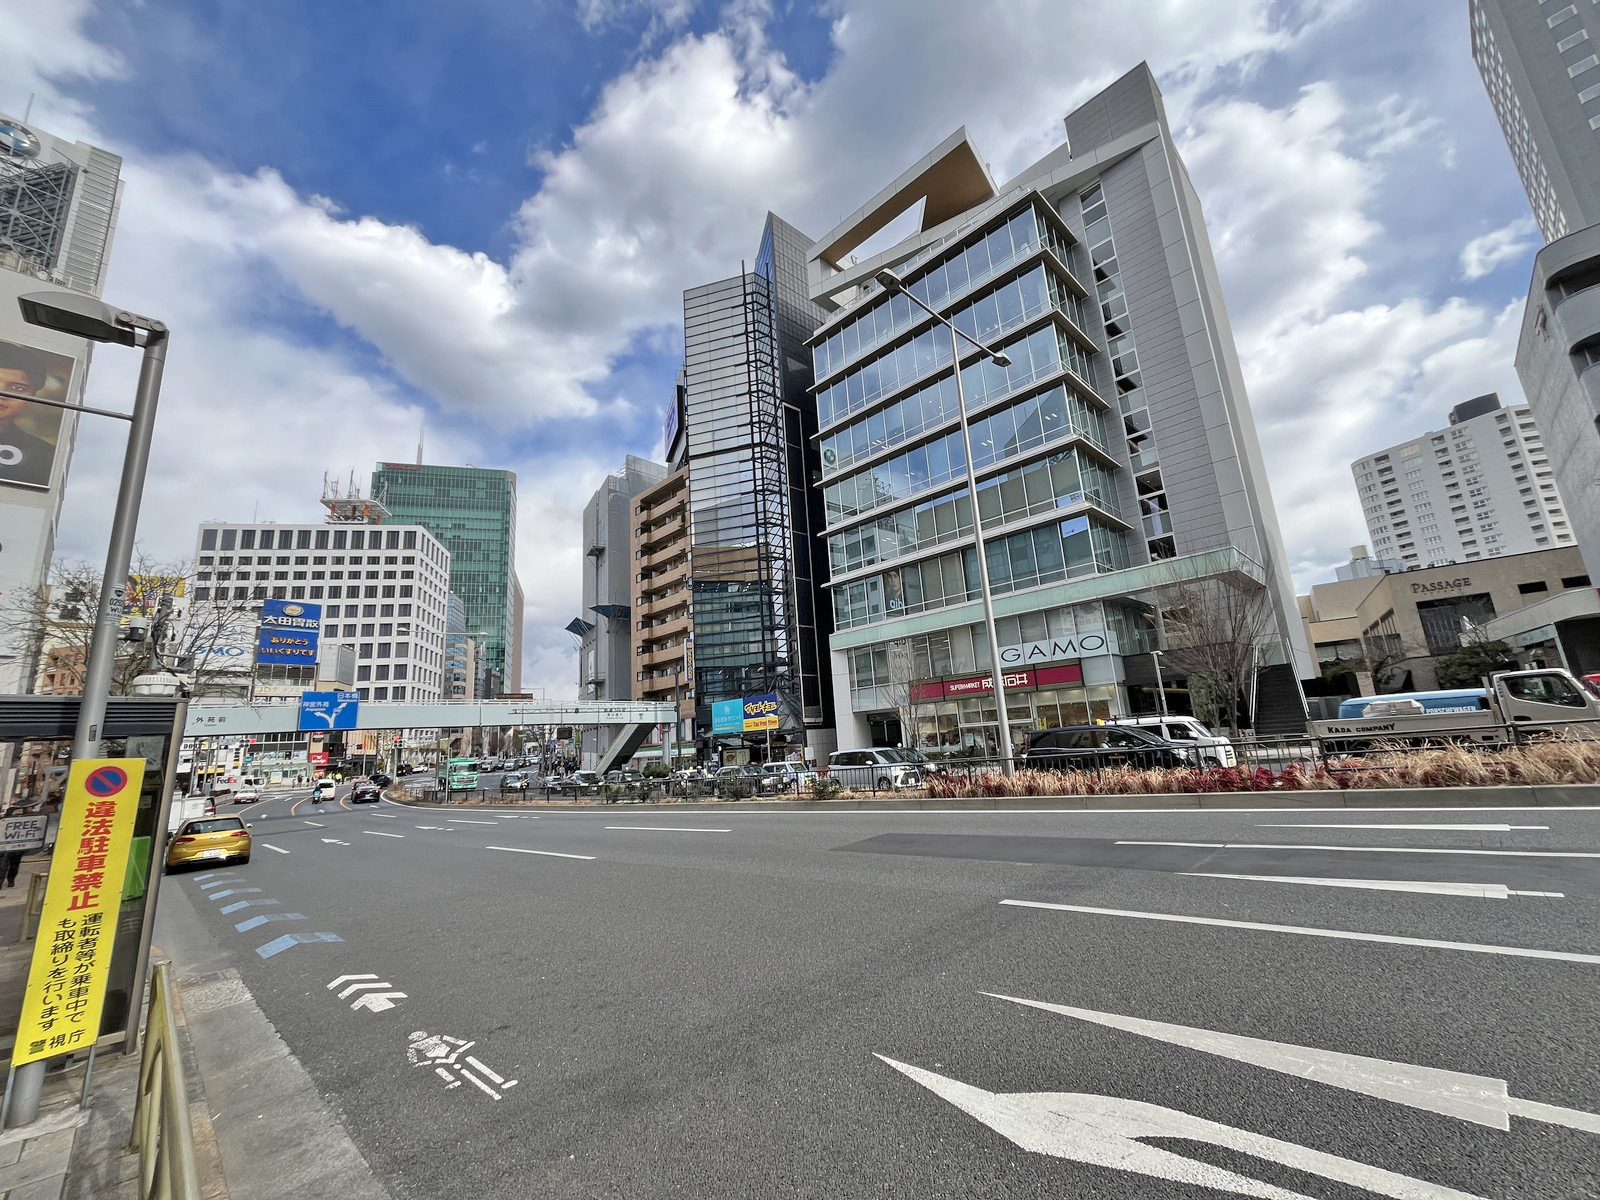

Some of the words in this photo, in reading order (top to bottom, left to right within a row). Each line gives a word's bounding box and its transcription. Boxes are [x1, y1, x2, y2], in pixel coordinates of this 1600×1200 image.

[1410, 577, 1472, 594] PASSAGE
[263, 615, 319, 629] 太田胃散
[271, 636, 309, 646] ありがとう
[261, 647, 315, 657] いいくすりです
[1000, 635, 1105, 663] GAMO
[949, 681, 980, 692] SUPERMARKET
[981, 672, 1028, 690] 成石井
[195, 716, 227, 724] 外苑前
[1355, 722, 1396, 733] COMPANY
[216, 776, 238, 784] FedEx
[5, 820, 39, 831] FREE
[4, 829, 36, 840] Wi-Fi
[66, 801, 118, 912] 違法駐車禁止
[65, 911, 104, 1023] 運転者等が乗車中で
[37, 917, 77, 1032] も取締りを行います
[28, 1028, 86, 1055] 警視庁
